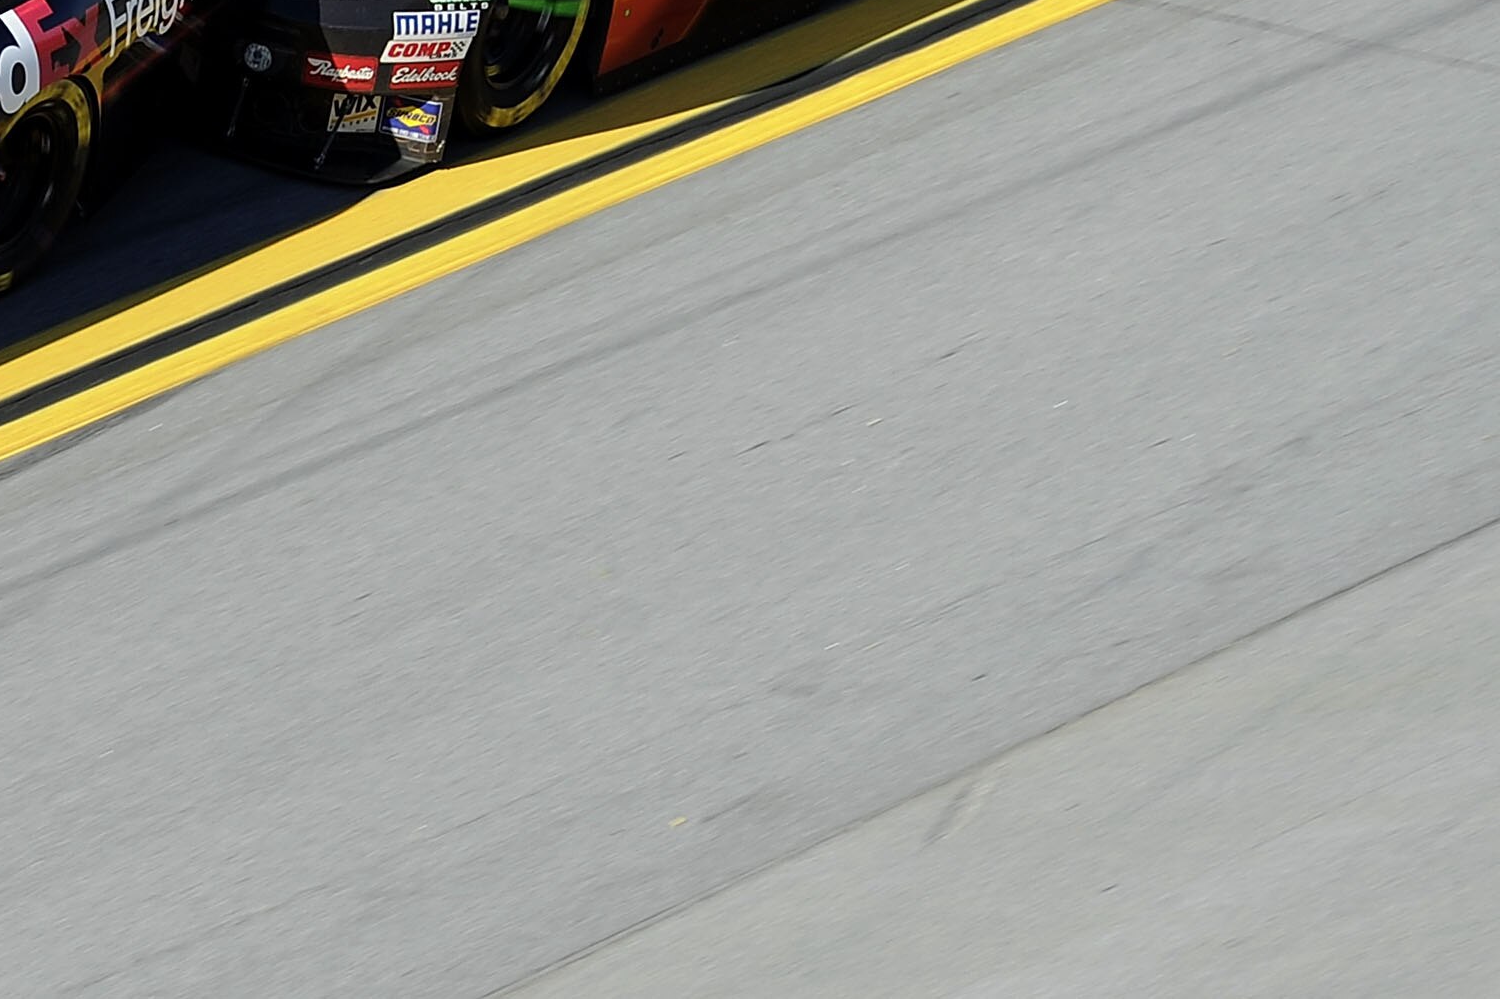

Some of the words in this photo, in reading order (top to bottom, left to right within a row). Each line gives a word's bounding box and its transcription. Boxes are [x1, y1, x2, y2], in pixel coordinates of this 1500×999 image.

[396, 12, 478, 36] MAHLE
[388, 42, 452, 58] COMP
[391, 65, 460, 84] Edelbrock
